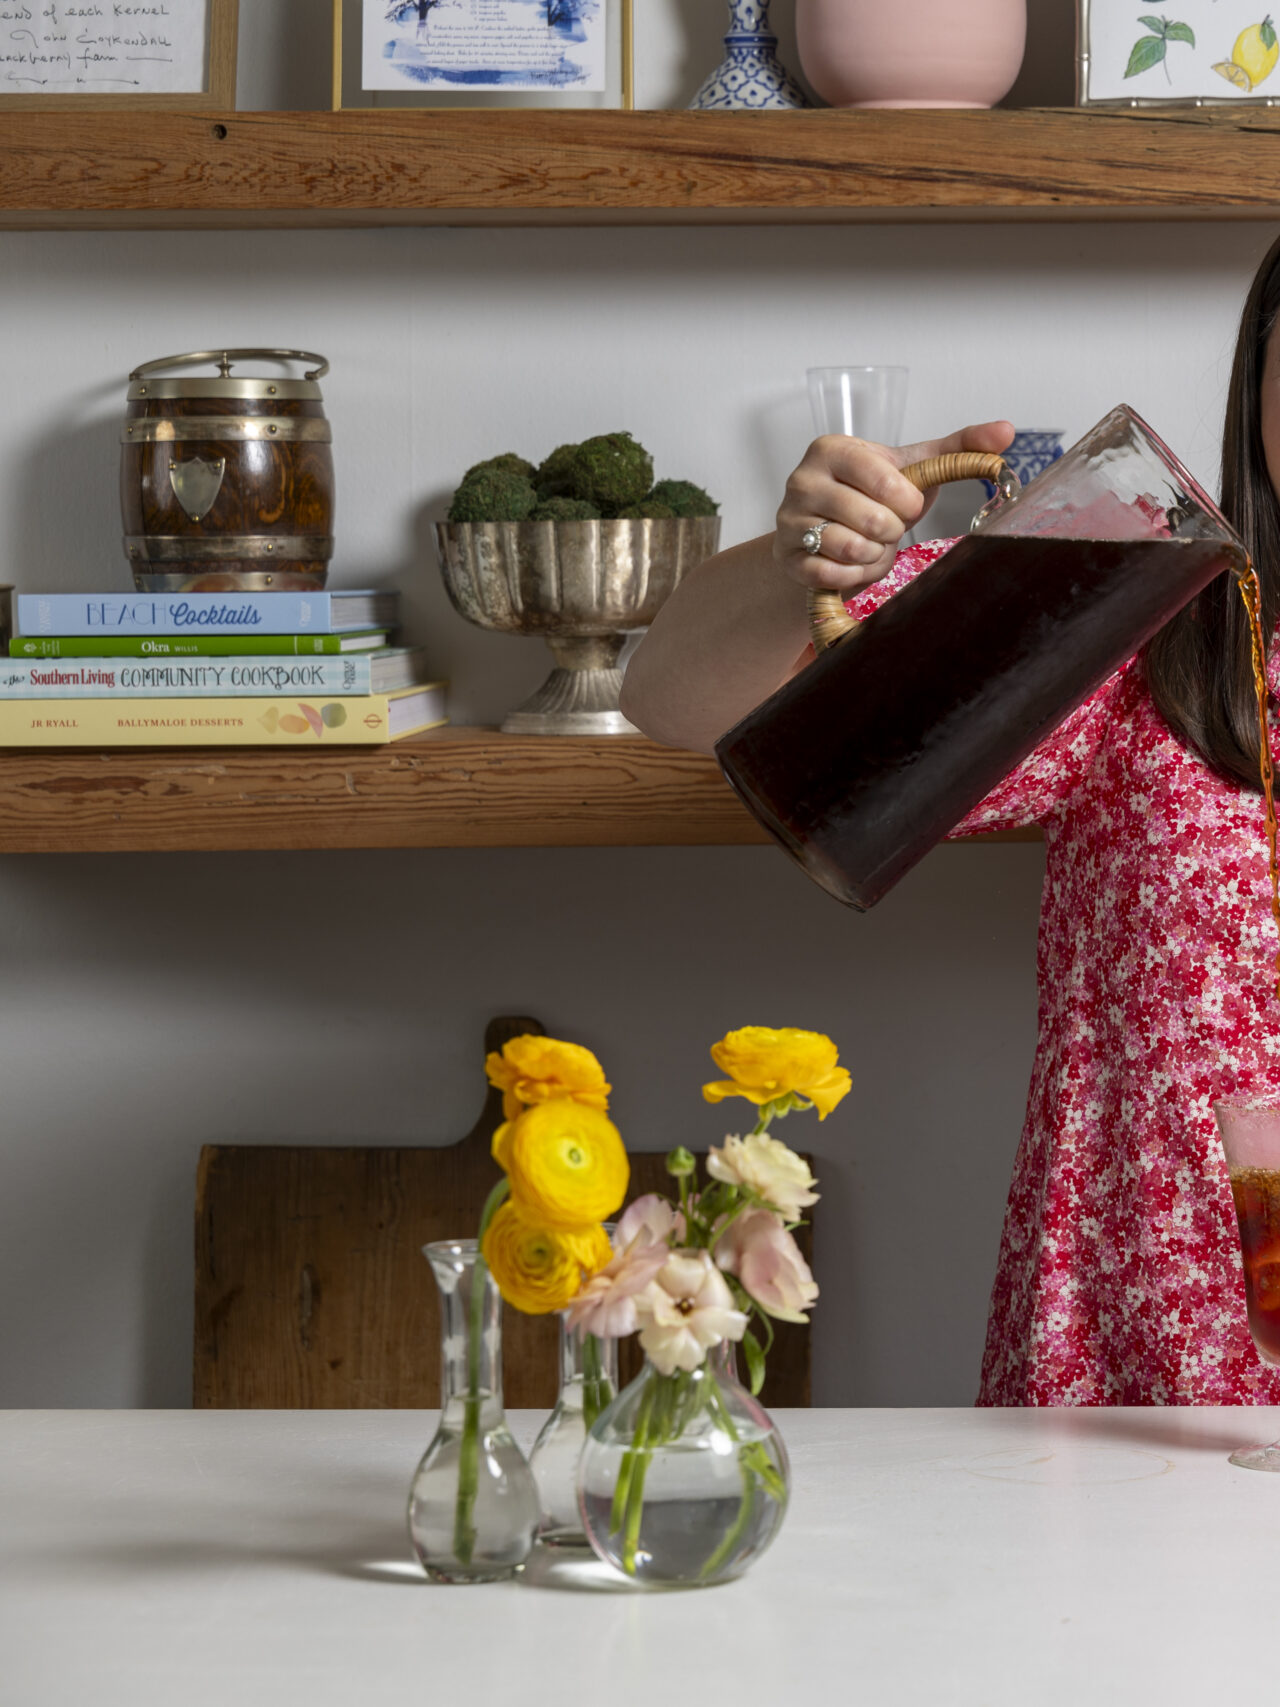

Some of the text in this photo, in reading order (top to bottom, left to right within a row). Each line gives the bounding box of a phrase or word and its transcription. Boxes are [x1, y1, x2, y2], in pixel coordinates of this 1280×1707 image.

[42, 4, 58, 25] of
[64, 6, 104, 17] each
[87, 601, 263, 627] BEACH Cocktails
[141, 640, 198, 654] Okra WILLIS
[29, 669, 80, 687] Southern
[80, 668, 116, 689] Living
[120, 667, 226, 689] COMMUNITY
[230, 665, 326, 691] COOKBOOK
[30, 717, 245, 729] JR RYALL BALLYMALOE DESSERTS
